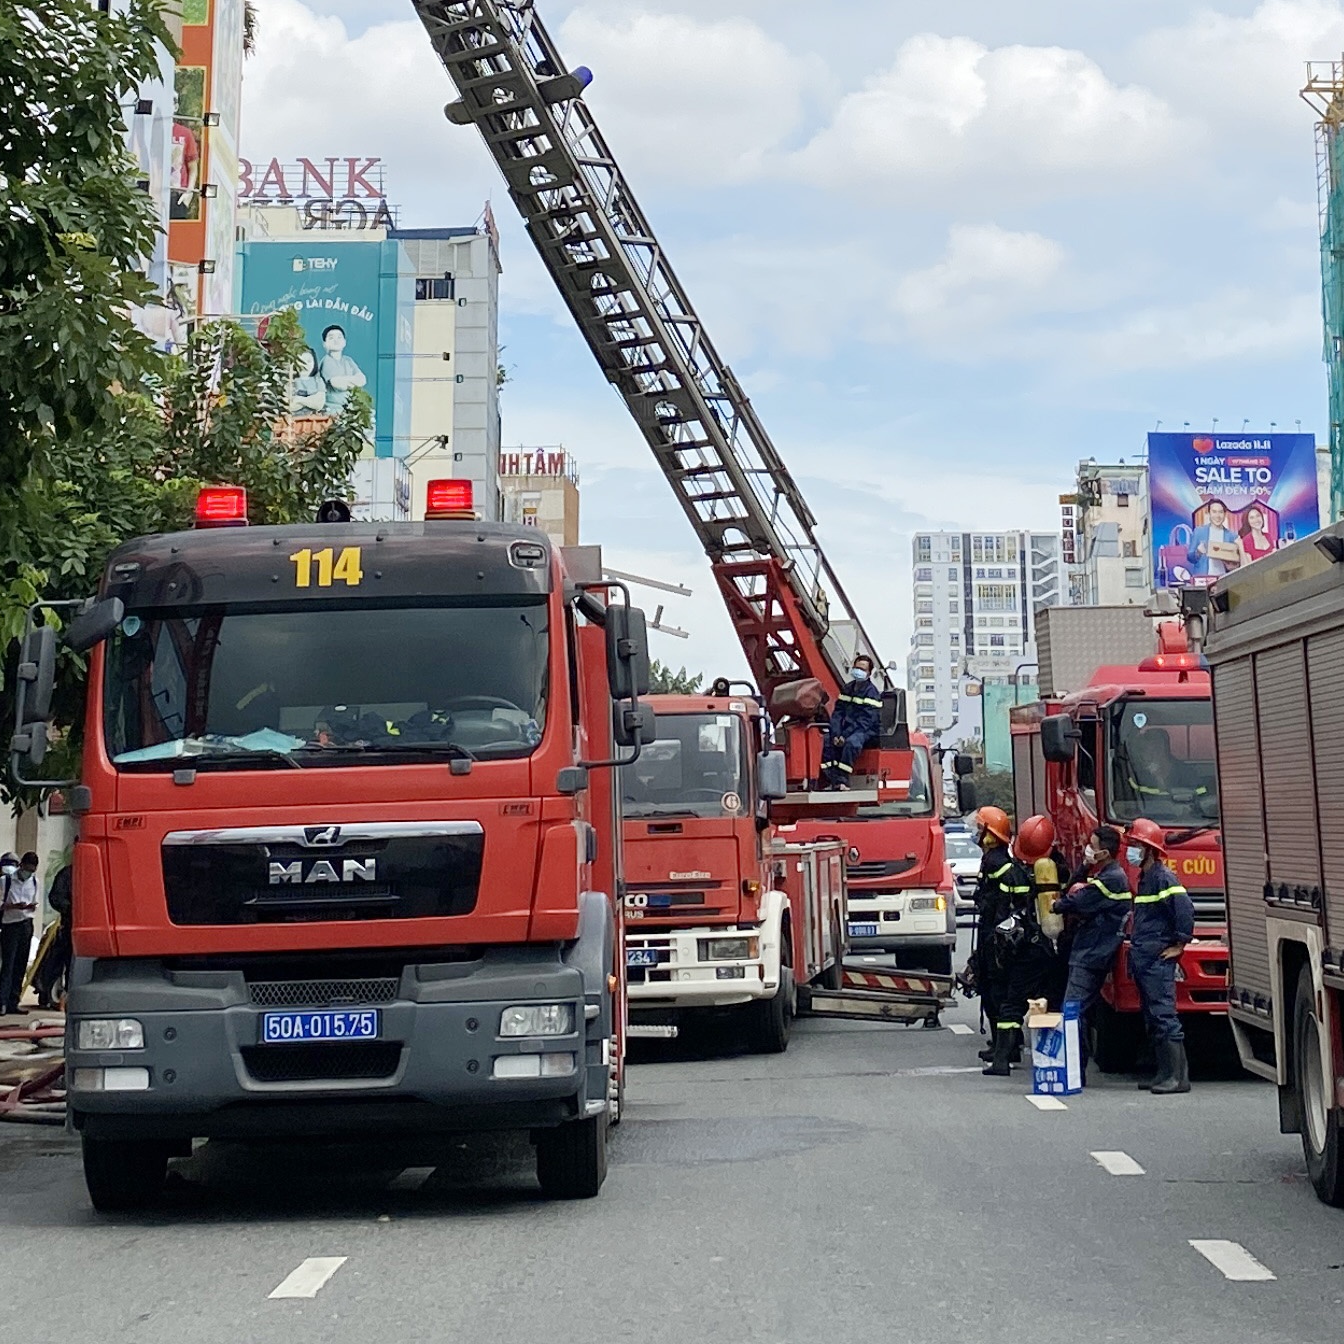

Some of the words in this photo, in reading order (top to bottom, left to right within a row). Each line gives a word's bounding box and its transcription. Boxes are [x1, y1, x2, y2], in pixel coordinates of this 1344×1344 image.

[1216, 439, 1253, 450] Lazada
[521, 447, 565, 475] TÂM
[1195, 467, 1243, 483] SALE
[1244, 467, 1272, 483] TO
[289, 546, 363, 587] 114
[269, 859, 376, 885] MAN
[1182, 855, 1216, 875] CỨU
[268, 1013, 373, 1038] 50A-015.75
